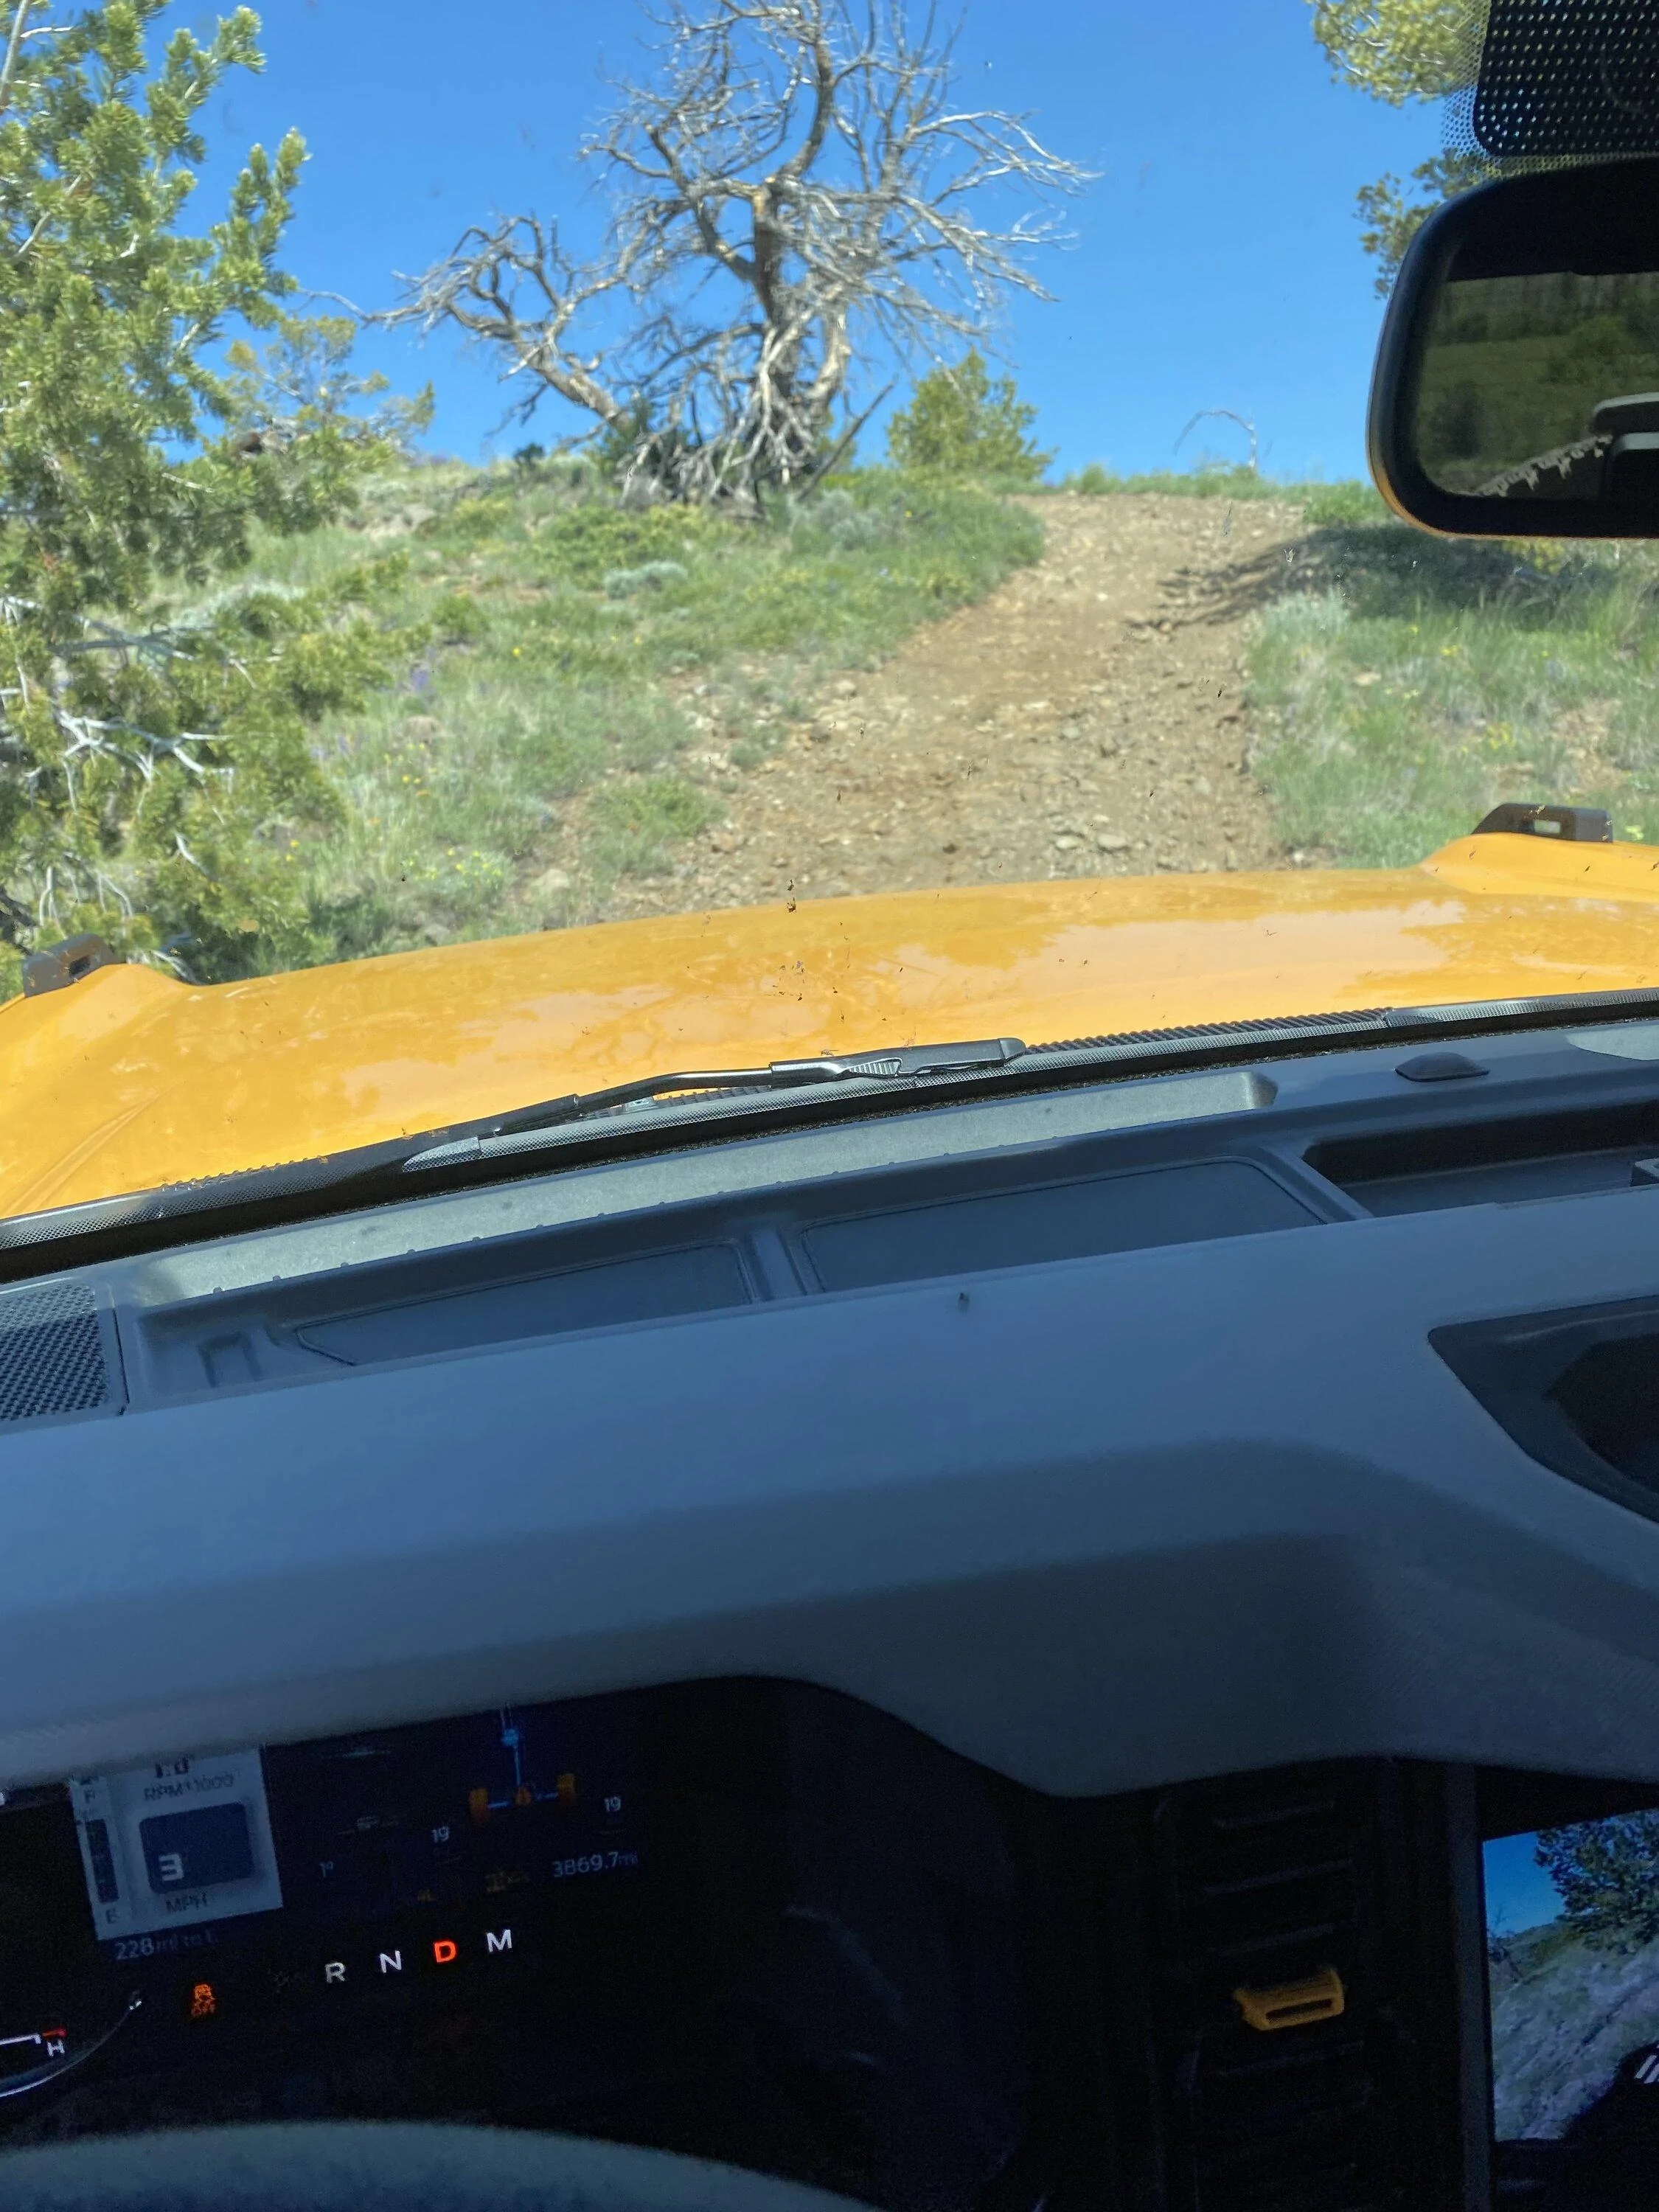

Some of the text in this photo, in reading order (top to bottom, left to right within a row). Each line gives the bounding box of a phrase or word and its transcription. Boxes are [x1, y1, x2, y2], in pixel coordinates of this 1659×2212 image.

[604, 1795, 622, 1812] 19
[431, 1825, 450, 1843] 19
[158, 1853, 184, 1881] 3
[166, 1892, 209, 1914] MPH
[324, 1929, 512, 1983] R N D M
[46, 2039, 66, 2057] H
